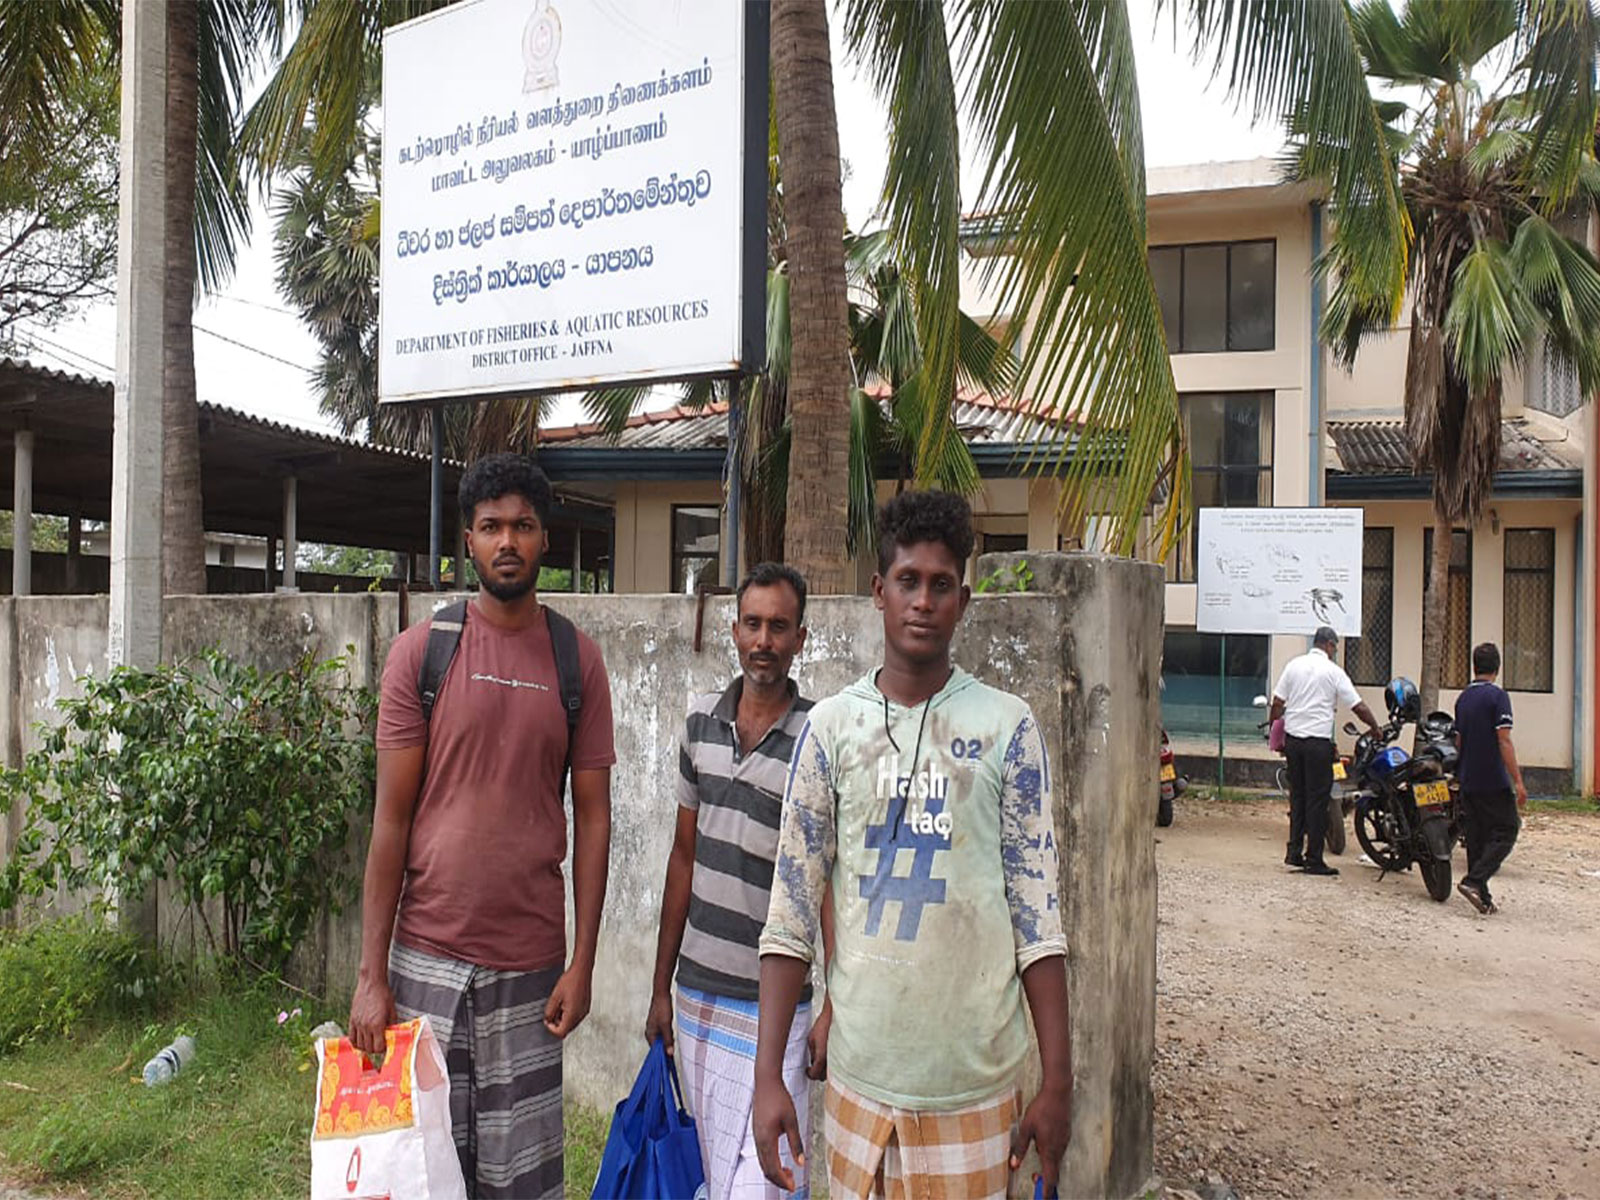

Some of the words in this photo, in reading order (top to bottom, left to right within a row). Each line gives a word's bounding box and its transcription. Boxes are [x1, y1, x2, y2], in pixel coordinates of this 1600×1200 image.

[477, 111, 519, 150] நீரியல்
[526, 97, 604, 129] வளத்துறை
[607, 57, 712, 115] திணைக்களம்
[431, 160, 478, 192] மாவட்ட
[481, 140, 556, 184] அலுவலகம்
[571, 112, 667, 161] யாழ்ப்பாணம்
[435, 229, 453, 250] හා
[458, 214, 495, 248] ජලජ
[500, 198, 555, 236] සම්පත්
[559, 169, 711, 228] දෙපාර්තමේන්තුව
[586, 245, 653, 275] යාපනය
[396, 331, 468, 355] DEPARTMENT
[469, 329, 485, 346] OF
[487, 320, 547, 344] FISHERIES
[549, 319, 559, 336] &
[565, 311, 623, 337] AQUATIC
[626, 299, 709, 327] RESOURCES
[472, 349, 518, 368] DISTRICT
[519, 345, 558, 363] OFFICE
[571, 339, 613, 357] JAFFNA
[951, 738, 982, 759] 02
[876, 754, 945, 800] Hash
